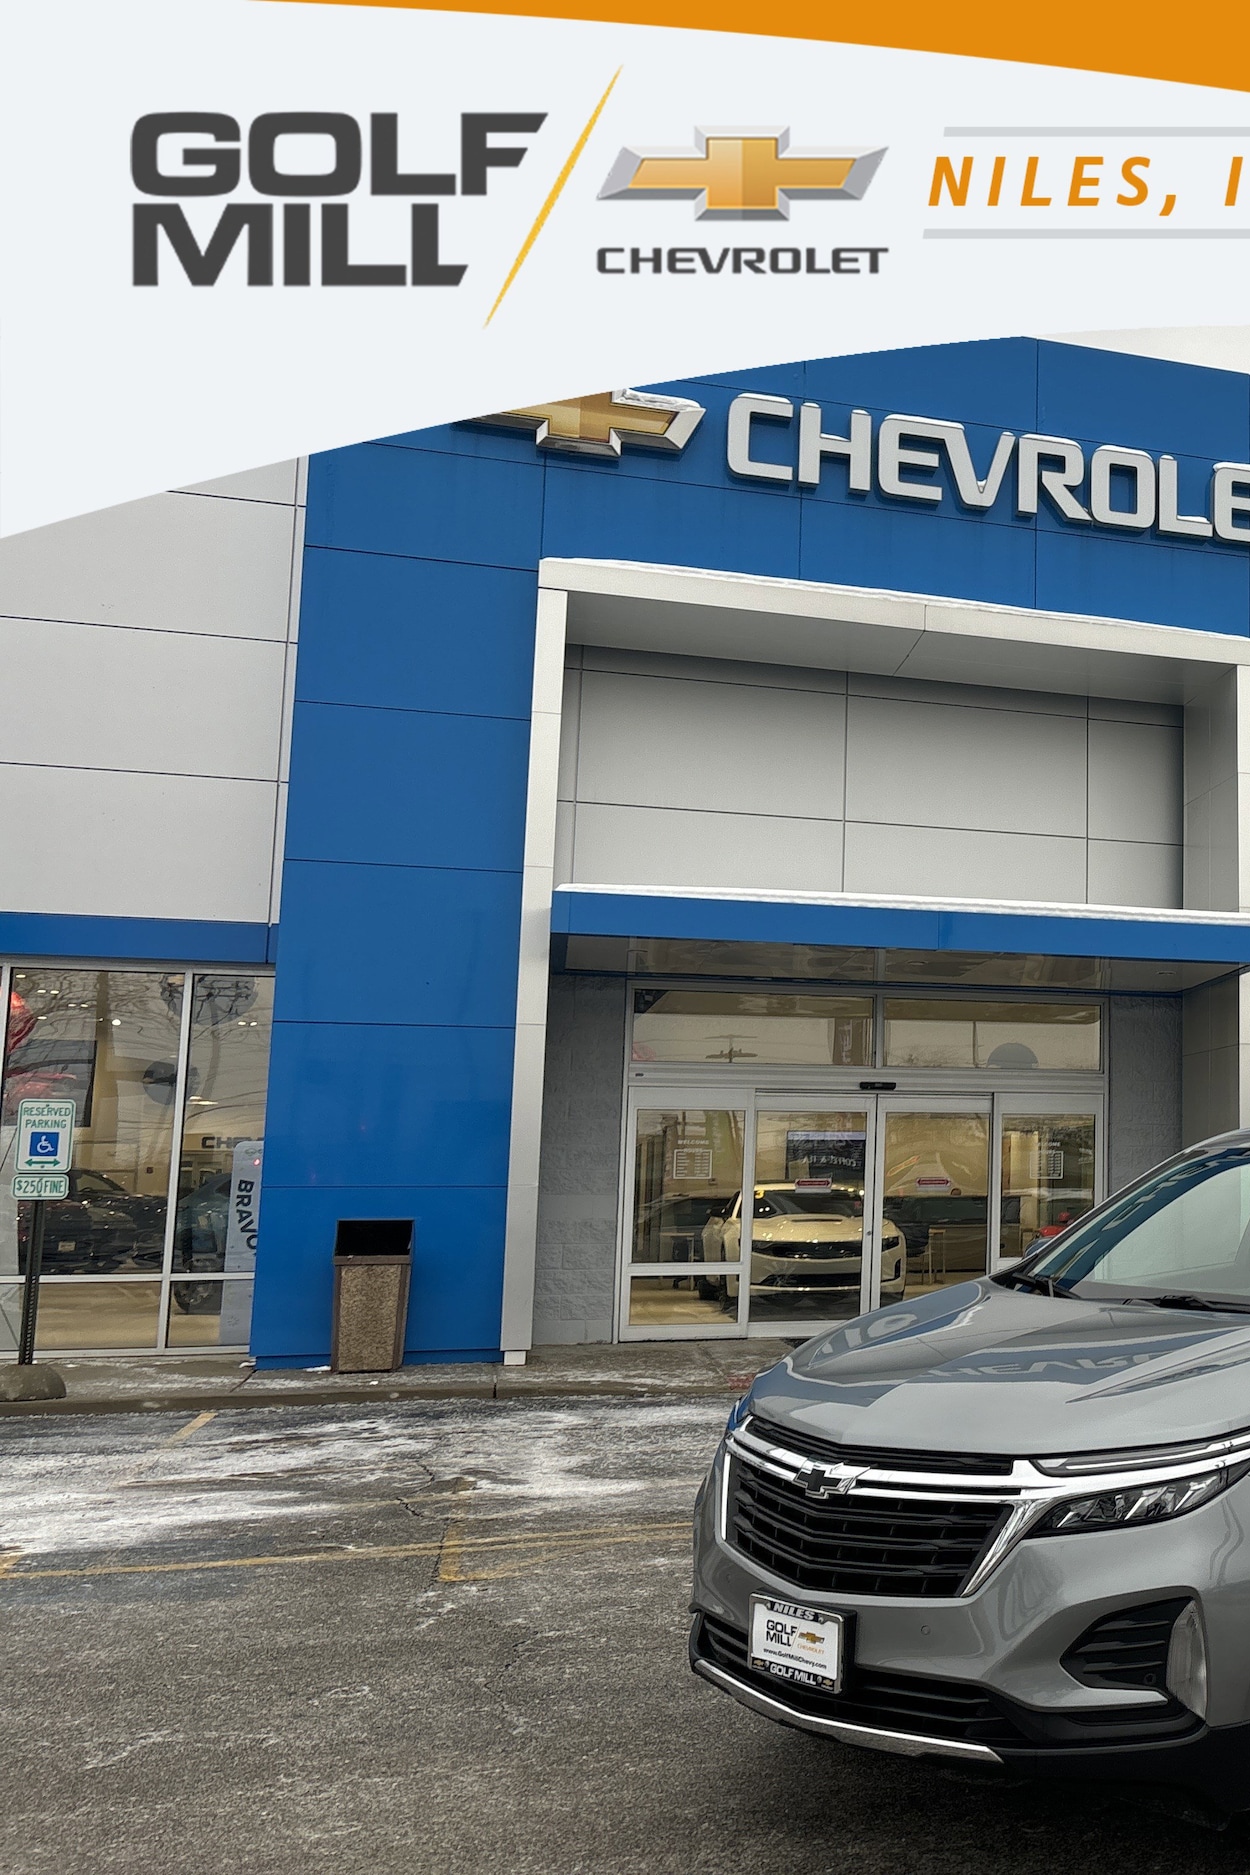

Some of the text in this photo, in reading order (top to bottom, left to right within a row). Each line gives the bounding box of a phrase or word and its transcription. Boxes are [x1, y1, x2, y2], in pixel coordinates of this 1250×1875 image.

[23, 1106, 71, 1116] RESERVED
[25, 1119, 67, 1128] PARKING
[16, 1180, 64, 1194] $250 FINE
[773, 1603, 815, 1621] NILES
[766, 1619, 798, 1637] GOLF
[766, 1631, 791, 1647] MILL
[763, 1648, 827, 1669] www.GolfMillChevy.com
[770, 1663, 795, 1678] GOLF
[794, 1669, 817, 1686] MILL
